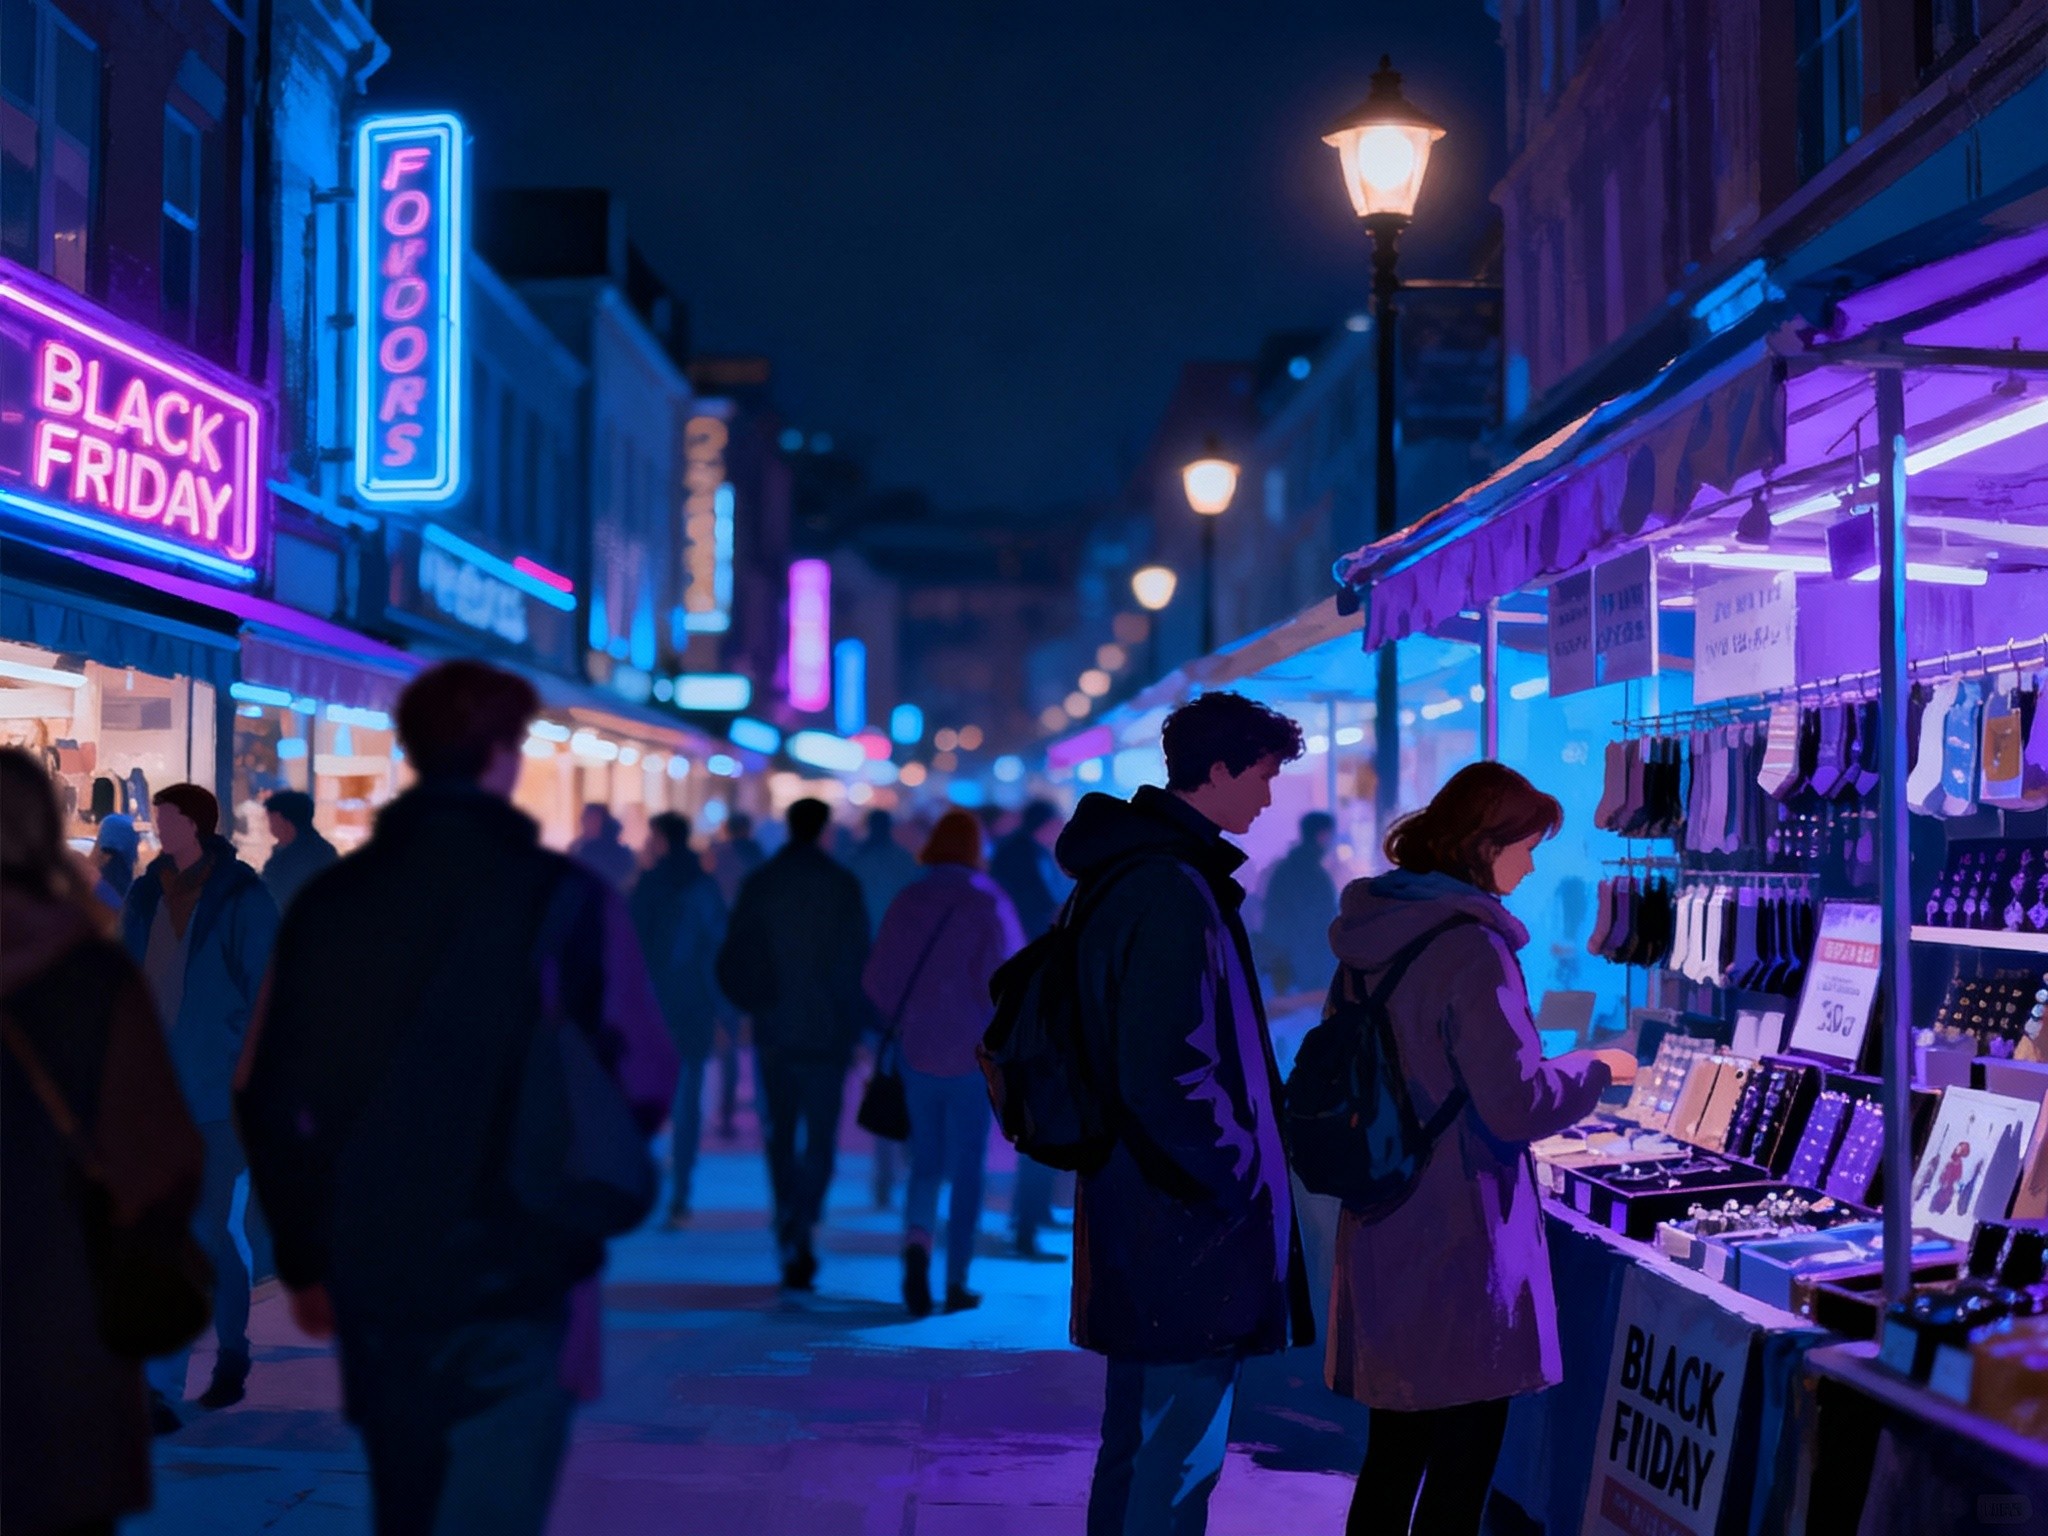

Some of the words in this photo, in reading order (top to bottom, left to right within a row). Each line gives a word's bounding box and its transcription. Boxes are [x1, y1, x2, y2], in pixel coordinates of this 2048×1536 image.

[41, 340, 224, 473] BLACK
[36, 420, 233, 540] FRIDAY
[1620, 1323, 1725, 1437] BLACK
